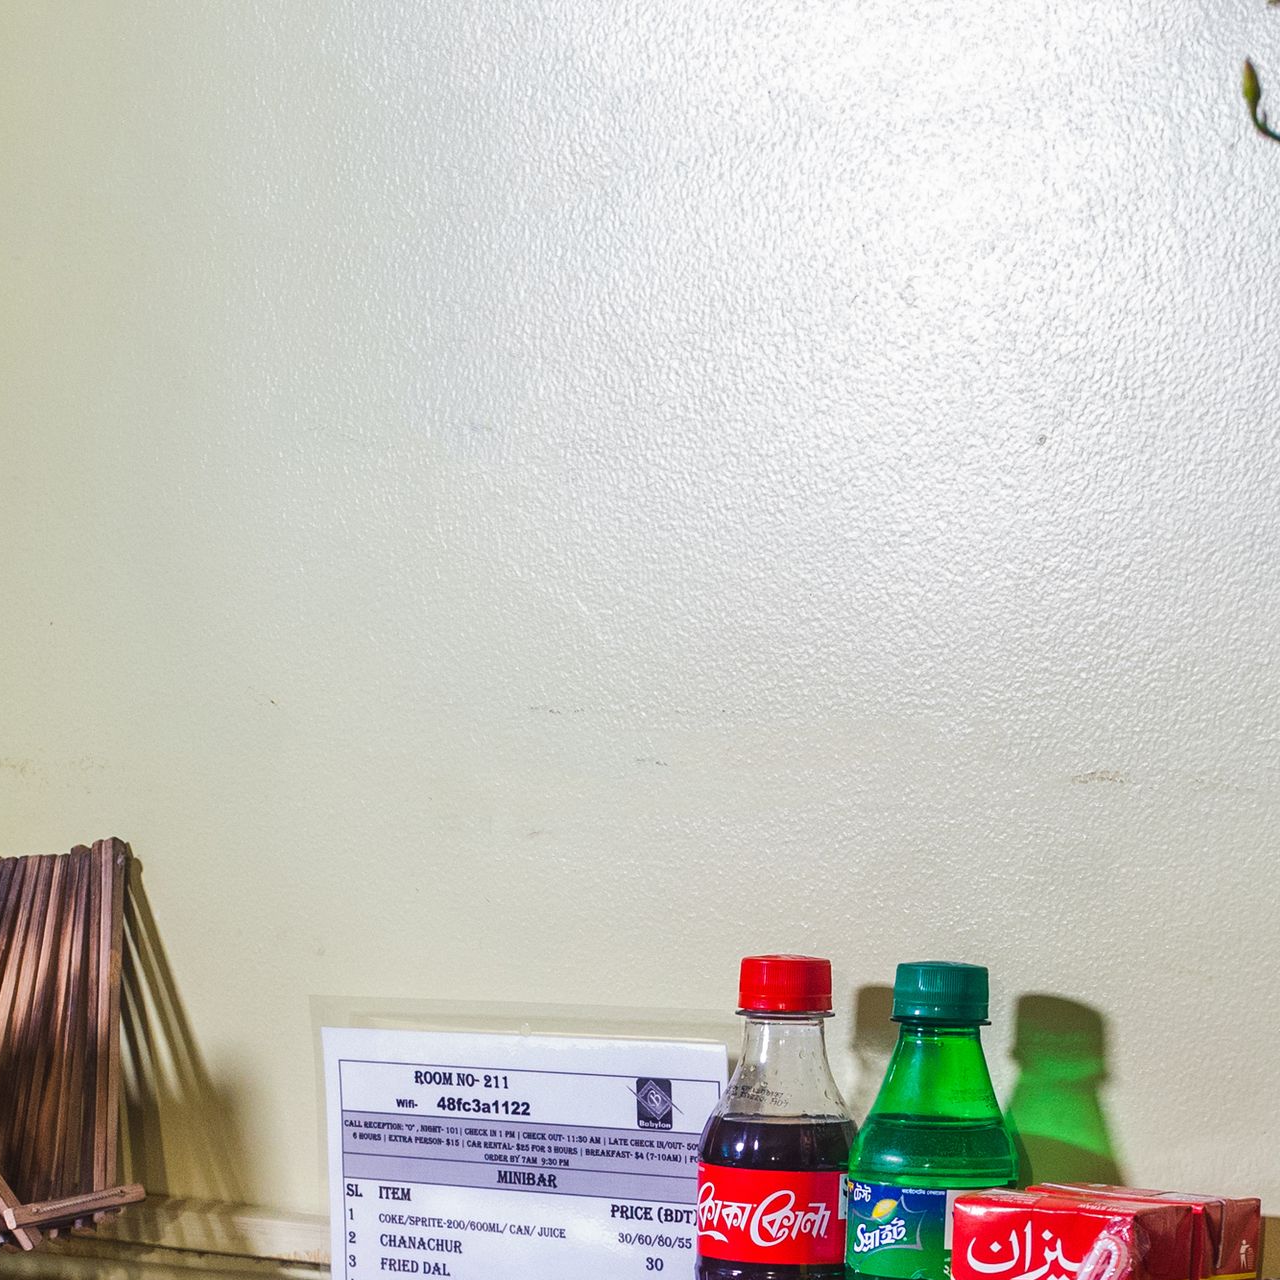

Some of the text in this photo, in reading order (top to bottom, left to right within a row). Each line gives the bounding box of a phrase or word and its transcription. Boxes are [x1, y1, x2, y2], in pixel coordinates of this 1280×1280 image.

[414, 1070, 453, 1086] ROOM
[483, 1075, 509, 1089] 211
[437, 1096, 531, 1116] 48fc3a1122
[344, 1119, 363, 1128] CALL
[363, 1120, 404, 1131] RECEPTION:
[464, 1128, 488, 1137] CHECK
[489, 1129, 497, 1138] IN
[504, 1130, 516, 1139] PM
[522, 1132, 546, 1141] CHECK
[589, 1135, 601, 1144] AM
[608, 1137, 629, 1146] LATE
[630, 1138, 655, 1148] CHECK
[639, 1120, 672, 1129] Babylon
[359, 1132, 382, 1141] HOURS
[388, 1134, 413, 1144] EXTRA
[466, 1140, 482, 1149] CAR
[531, 1144, 546, 1153] FOR
[554, 1146, 578, 1155] HOURS
[484, 1154, 570, 1167] ORDER BY 7AM 9:30 PM
[497, 1170, 558, 1188] MINIBAR
[346, 1184, 363, 1198] SL
[378, 1186, 412, 1201] ITEM
[610, 1203, 653, 1222] PRICE
[348, 1208, 354, 1220] 1
[537, 1226, 567, 1239] JUICE
[618, 1232, 692, 1249] 30/60/80/55
[348, 1231, 664, 1271] 2 CHANACHUR 30
[349, 1255, 356, 1268] 3
[380, 1257, 419, 1274] FRIED
[423, 1260, 451, 1277] DAL
